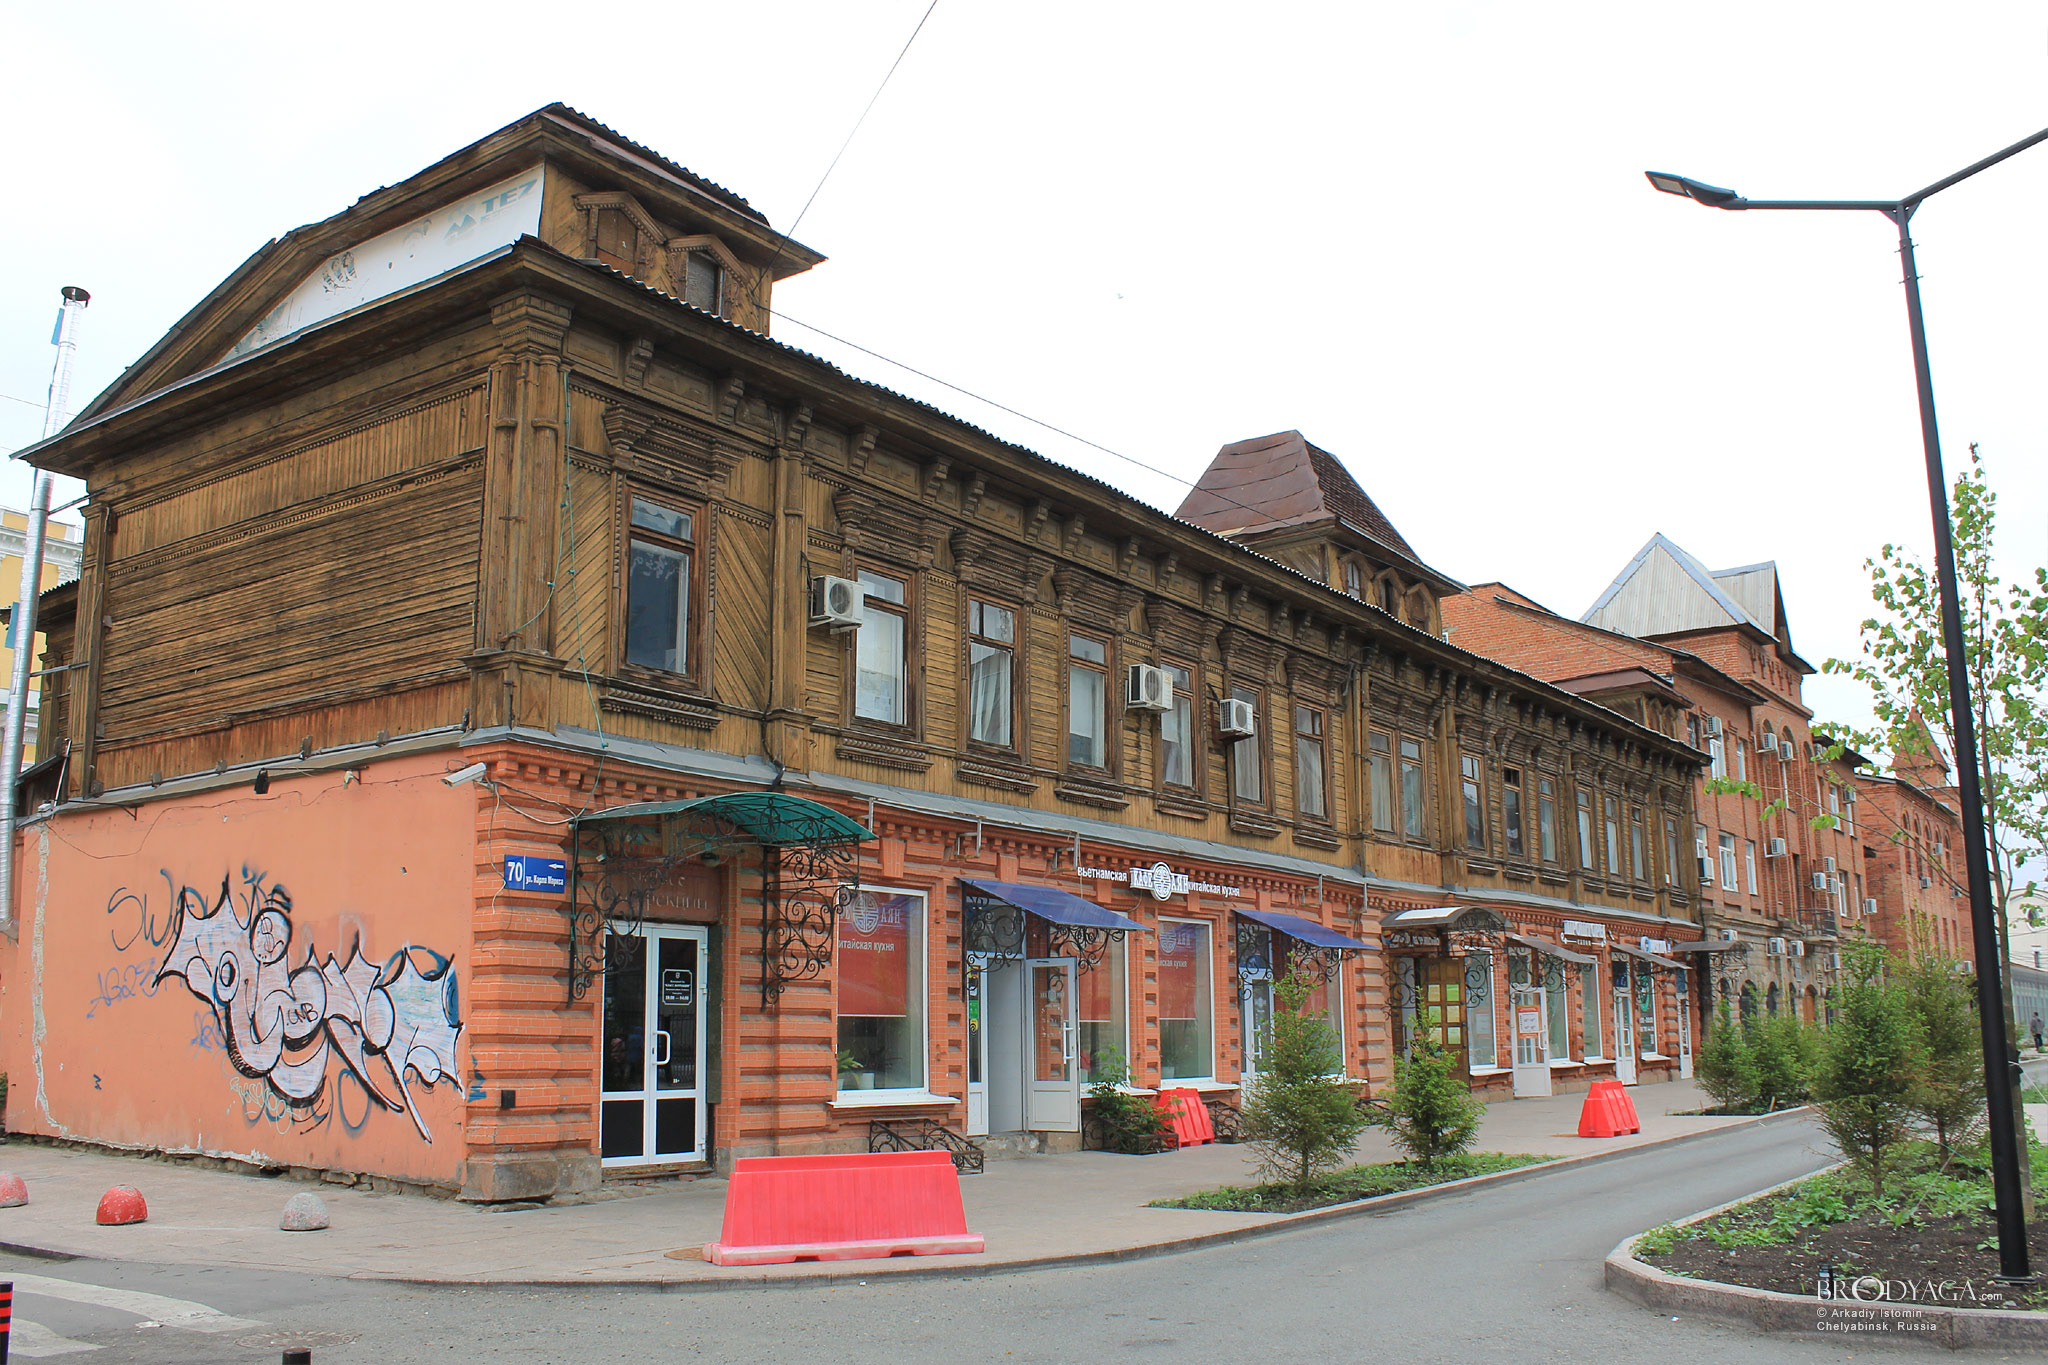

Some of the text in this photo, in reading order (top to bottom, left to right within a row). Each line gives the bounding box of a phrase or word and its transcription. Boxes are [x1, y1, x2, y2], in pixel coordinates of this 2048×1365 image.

[508, 861, 523, 882] 70
[1077, 866, 1128, 882] вьетнамская
[548, 875, 564, 887] Маркса
[1133, 870, 1188, 892] КАФЕ АЯН
[1221, 885, 1241, 898] кухня
[873, 941, 895, 954] кухня
